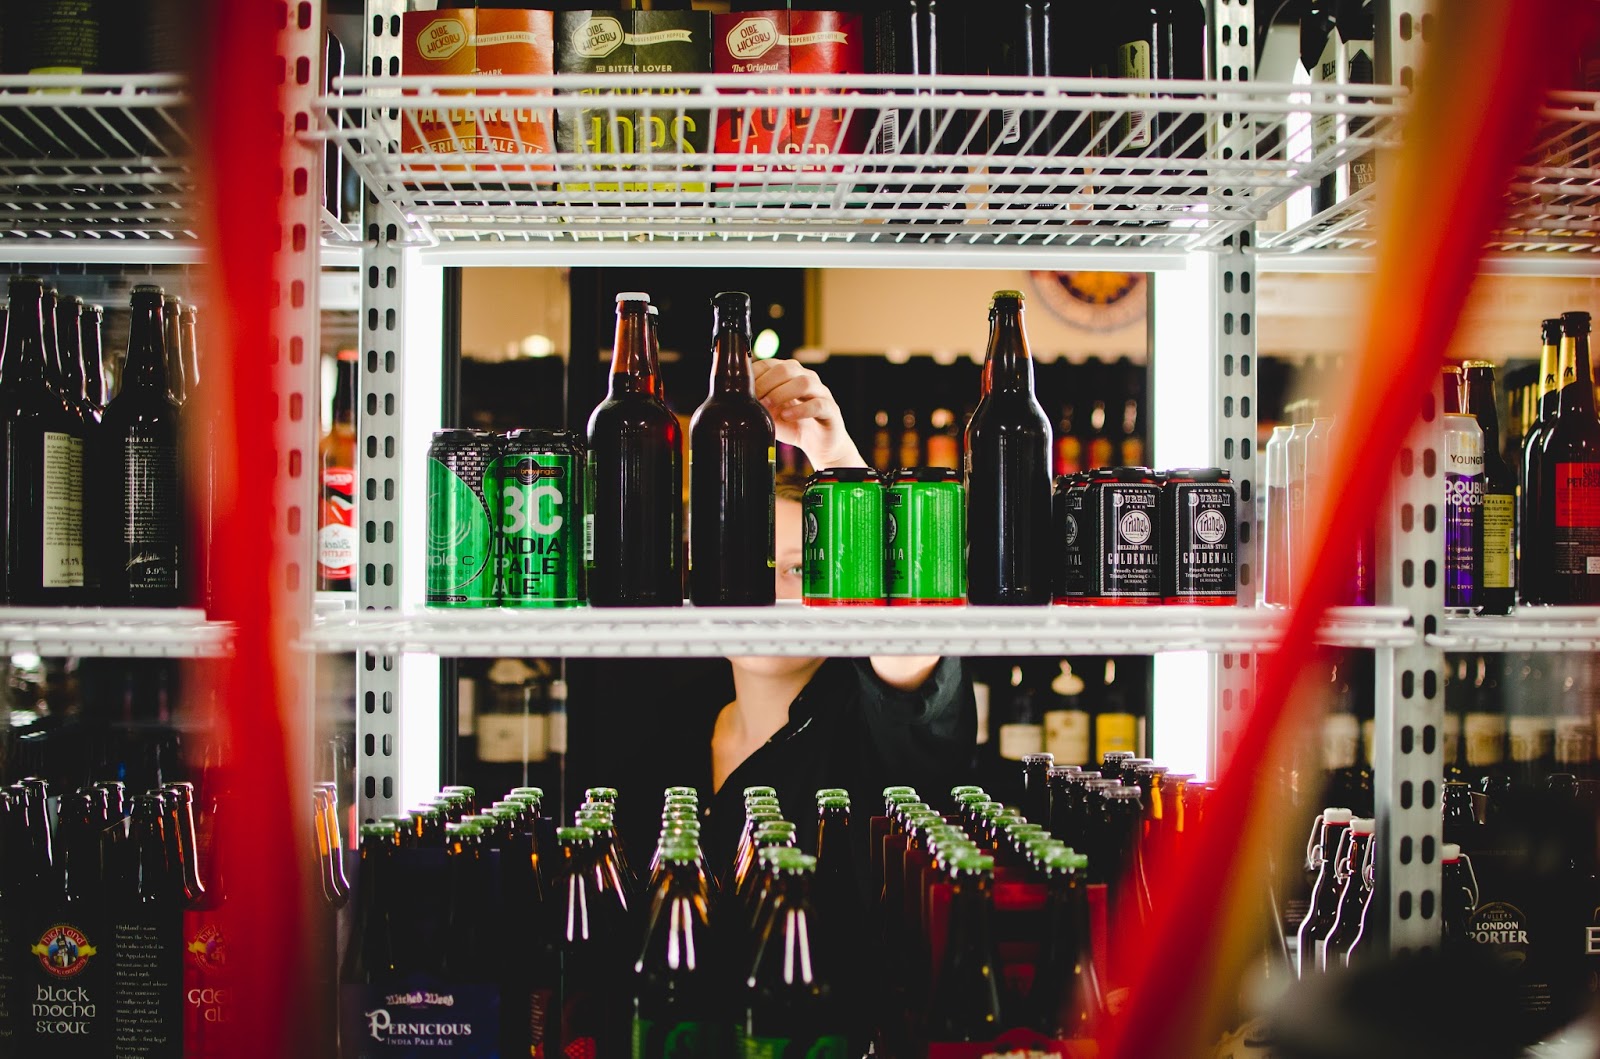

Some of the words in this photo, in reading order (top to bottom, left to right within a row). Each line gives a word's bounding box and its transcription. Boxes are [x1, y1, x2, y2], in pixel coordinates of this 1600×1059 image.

[430, 25, 448, 40] OLDE
[586, 24, 605, 38] OLDE
[740, 24, 759, 39] OLDE
[426, 34, 460, 54] HICKORY
[582, 32, 617, 52] HICKORY
[736, 32, 771, 53] HICKORY
[608, 65, 640, 73] BITTER
[643, 65, 672, 73] LOVER
[732, 64, 745, 73] The
[746, 63, 779, 74] Original
[1322, 60, 1336, 80] BELH
[482, 139, 514, 153] PALE
[574, 116, 697, 171] HOPS
[1353, 163, 1374, 175] CRA
[1446, 480, 1486, 495] DOUBL
[1567, 478, 1600, 488] PETERS
[1113, 493, 1156, 508] DURHAM
[1188, 492, 1231, 507] DURHAM
[1445, 494, 1484, 506] HOCOLA
[502, 486, 564, 535] 3C
[1124, 515, 1149, 537] Triangle
[1199, 514, 1224, 536] Triangle
[500, 537, 562, 555] INDIA
[1108, 552, 1145, 565] GOLDEN
[1146, 553, 1158, 565] ALE
[1183, 552, 1220, 564] GOLDEN
[1222, 552, 1234, 564] ALE
[500, 558, 560, 575] PALE
[500, 578, 541, 596] ALE
[1476, 921, 1519, 931] LONDON
[36, 984, 90, 1002] black
[32, 1002, 96, 1018] mocha
[36, 1020, 91, 1035] stout
